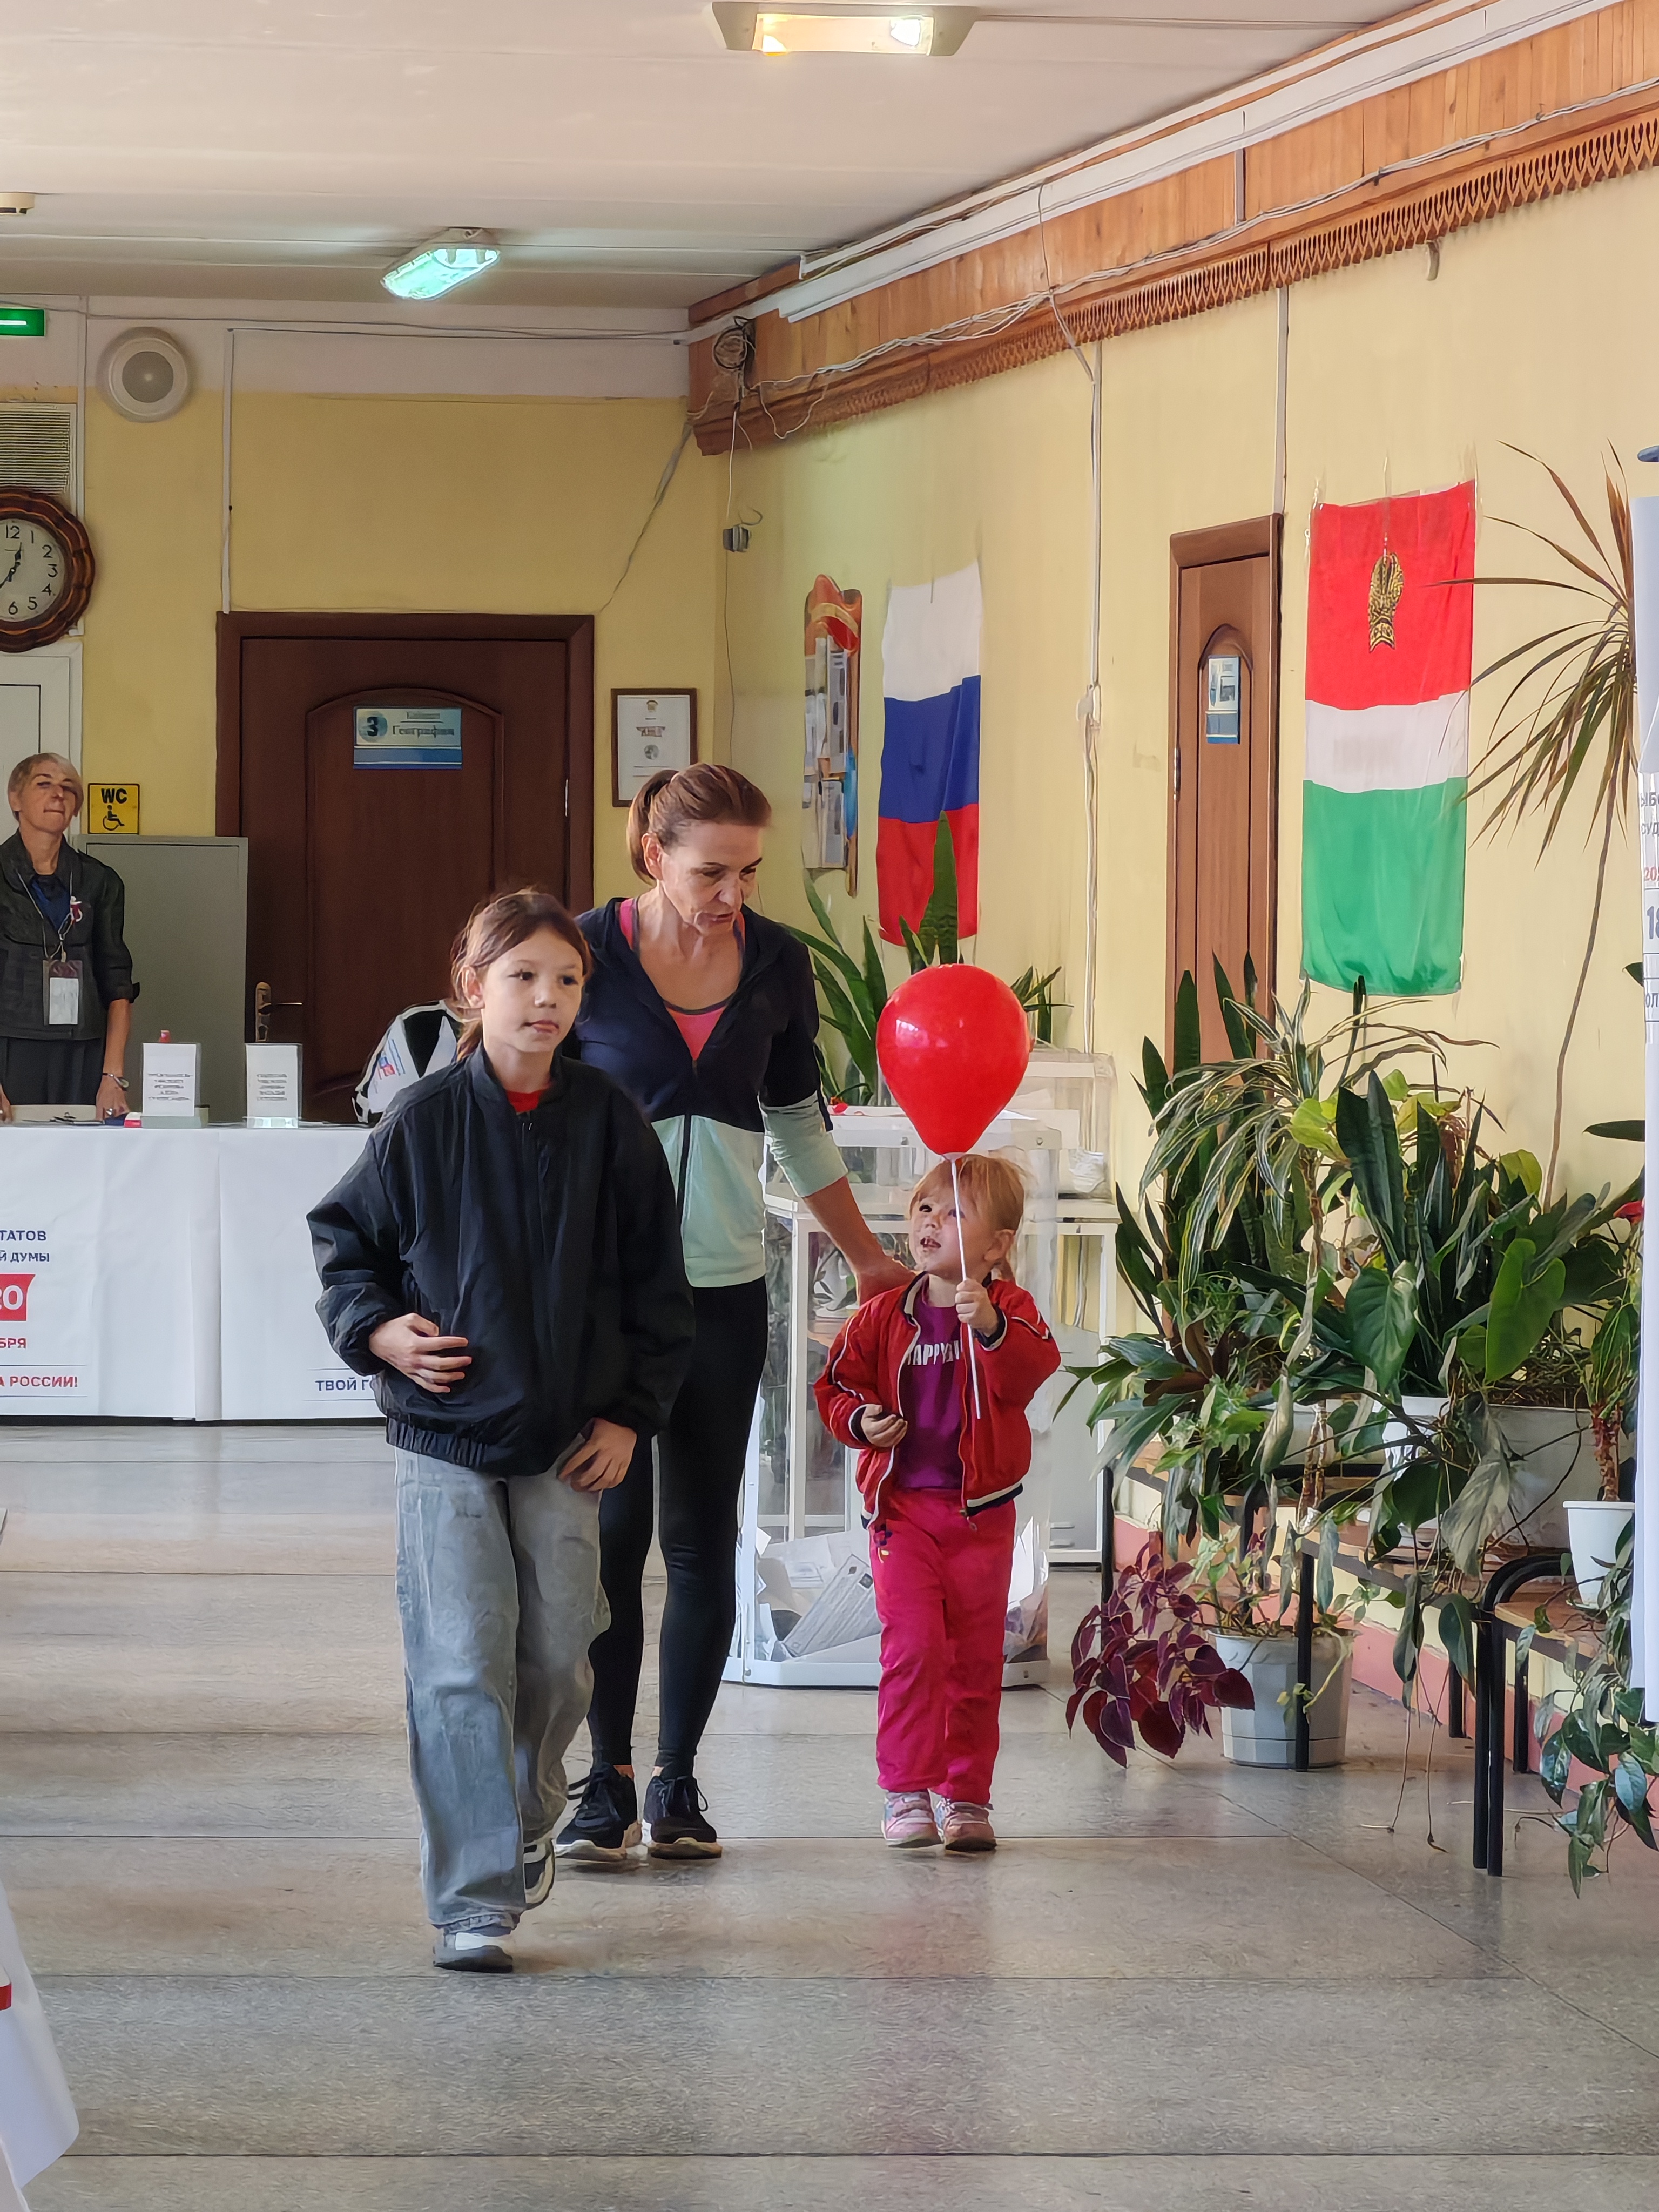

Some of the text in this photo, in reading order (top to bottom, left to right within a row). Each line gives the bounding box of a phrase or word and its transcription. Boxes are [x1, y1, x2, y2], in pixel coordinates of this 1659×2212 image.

[6, 525, 20, 539] 12
[31, 530, 34, 544] 1
[42, 544, 53, 558] 2
[48, 564, 58, 577] 3
[41, 583, 52, 596] 4
[8, 601, 18, 615] 6
[28, 596, 38, 610] 5
[367, 716, 379, 737] 3
[101, 788, 127, 804] WC
[0, 1230, 46, 1241] ТАТОВ
[10, 1252, 50, 1263] ДУМЫ
[0, 1338, 26, 1348] БРЯ
[10, 1376, 78, 1387] РОССИИ!
[315, 1377, 356, 1391] ТВОЙ
